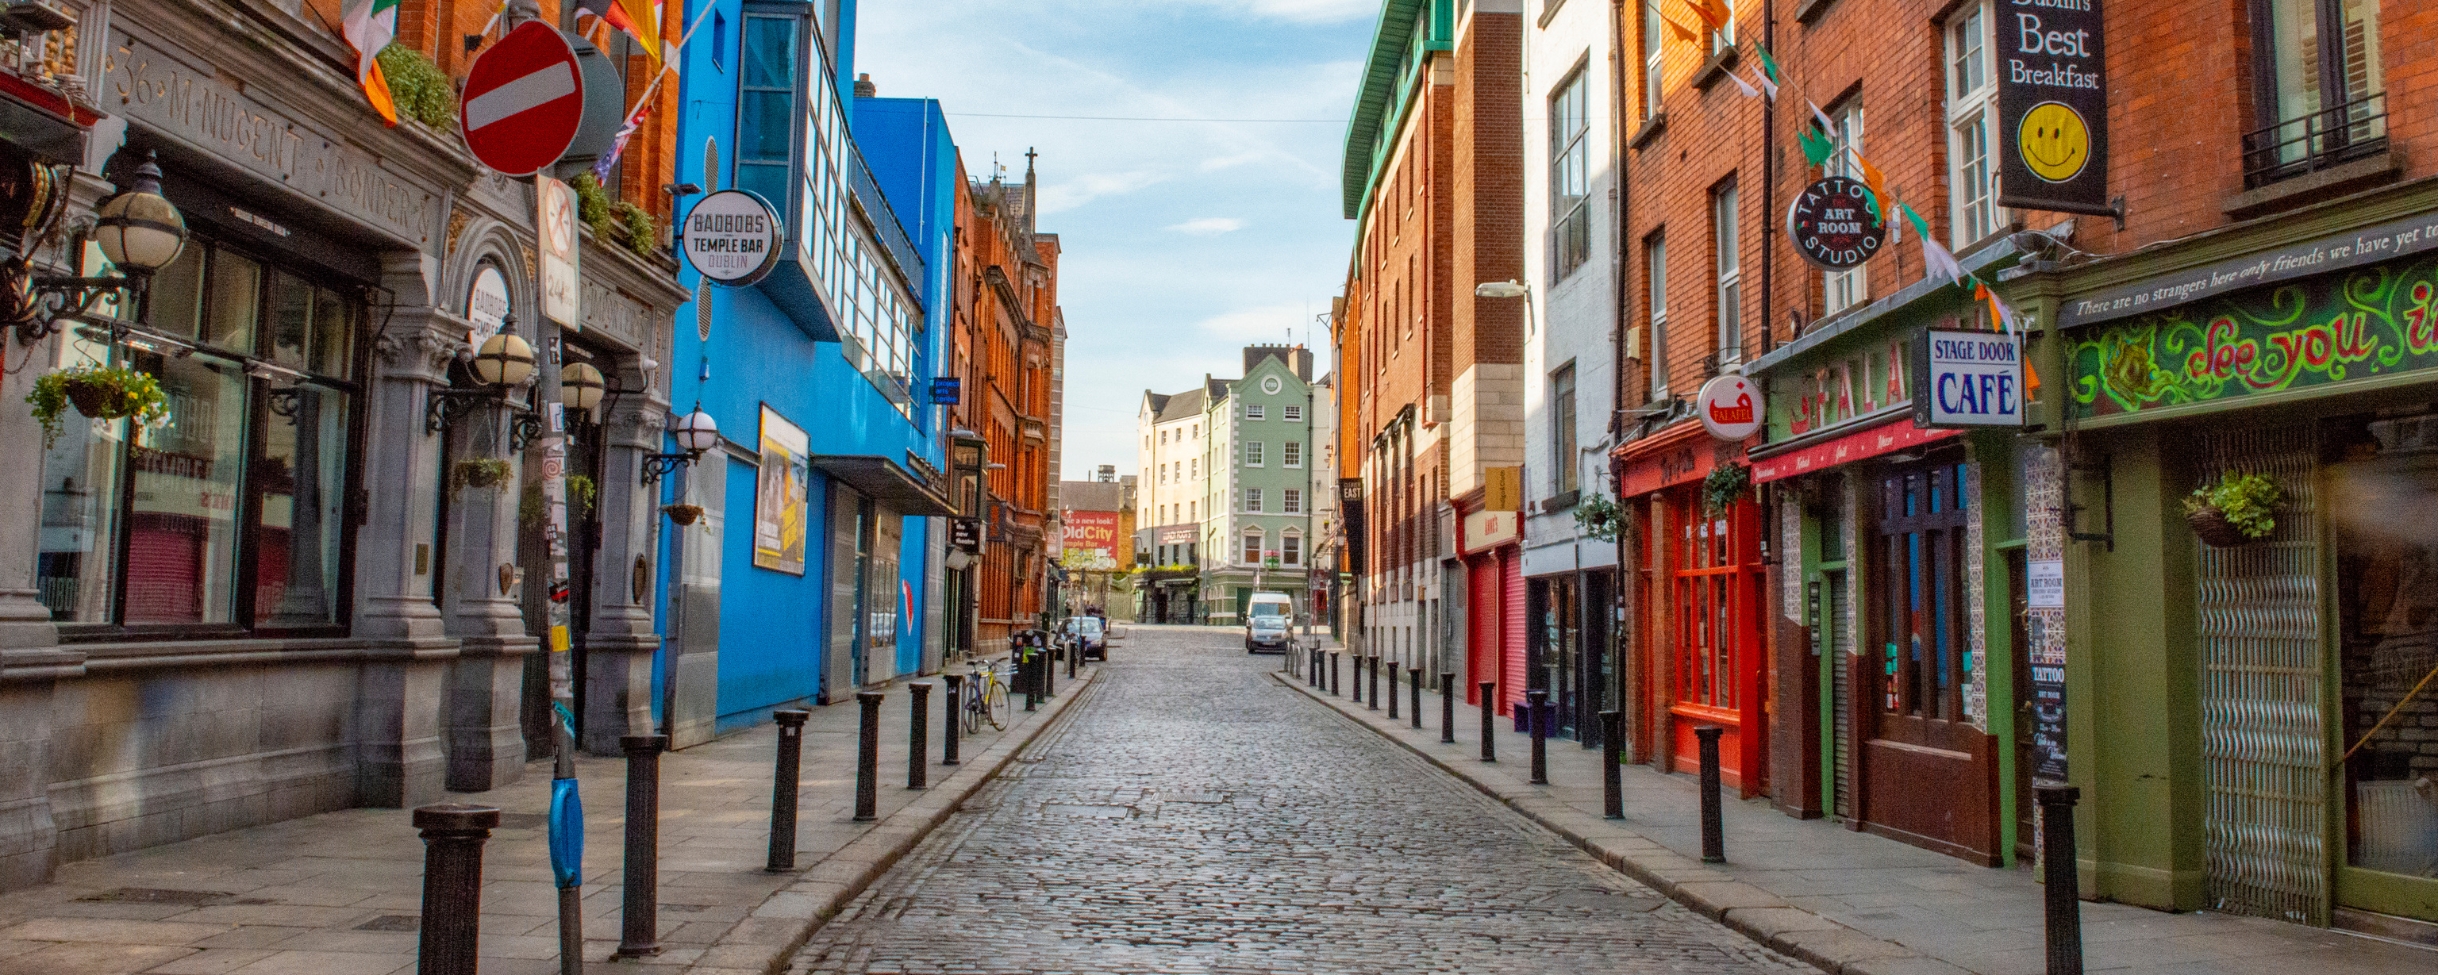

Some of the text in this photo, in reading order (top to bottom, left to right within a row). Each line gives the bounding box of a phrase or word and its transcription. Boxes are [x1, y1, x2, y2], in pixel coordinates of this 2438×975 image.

[2016, 13, 2091, 58] Best
[2009, 59, 2099, 90] Breakfast
[202, 87, 304, 177] NUGENT
[1823, 208, 1856, 220] ART
[693, 212, 765, 234] BADBOBS
[1817, 222, 1863, 234] ROOM
[693, 237, 764, 254] TEMPLE BAR
[1804, 235, 1878, 265] STUDIO
[708, 254, 749, 269] DUBLIN
[2076, 300, 2110, 316] There
[2113, 296, 2132, 310] are
[2134, 292, 2150, 306] no
[2152, 278, 2208, 301] strangers
[2209, 271, 2236, 288] here
[2239, 260, 2271, 280] only
[2270, 247, 2325, 272] friends
[2329, 245, 2351, 260] we
[2355, 236, 2390, 256] have
[2394, 228, 2421, 253] yet
[1935, 339, 2016, 361] STAGE DOOR
[2247, 313, 2374, 390] you
[1936, 369, 2017, 415] CAFÉ
[1713, 409, 1752, 422] FALAFEL
[1344, 487, 1361, 499] EAST
[1096, 517, 1113, 525] look!
[1064, 541, 1084, 549] emple
[2031, 578, 2062, 588] ART ROOM
[2032, 666, 2065, 683] TATTOO
